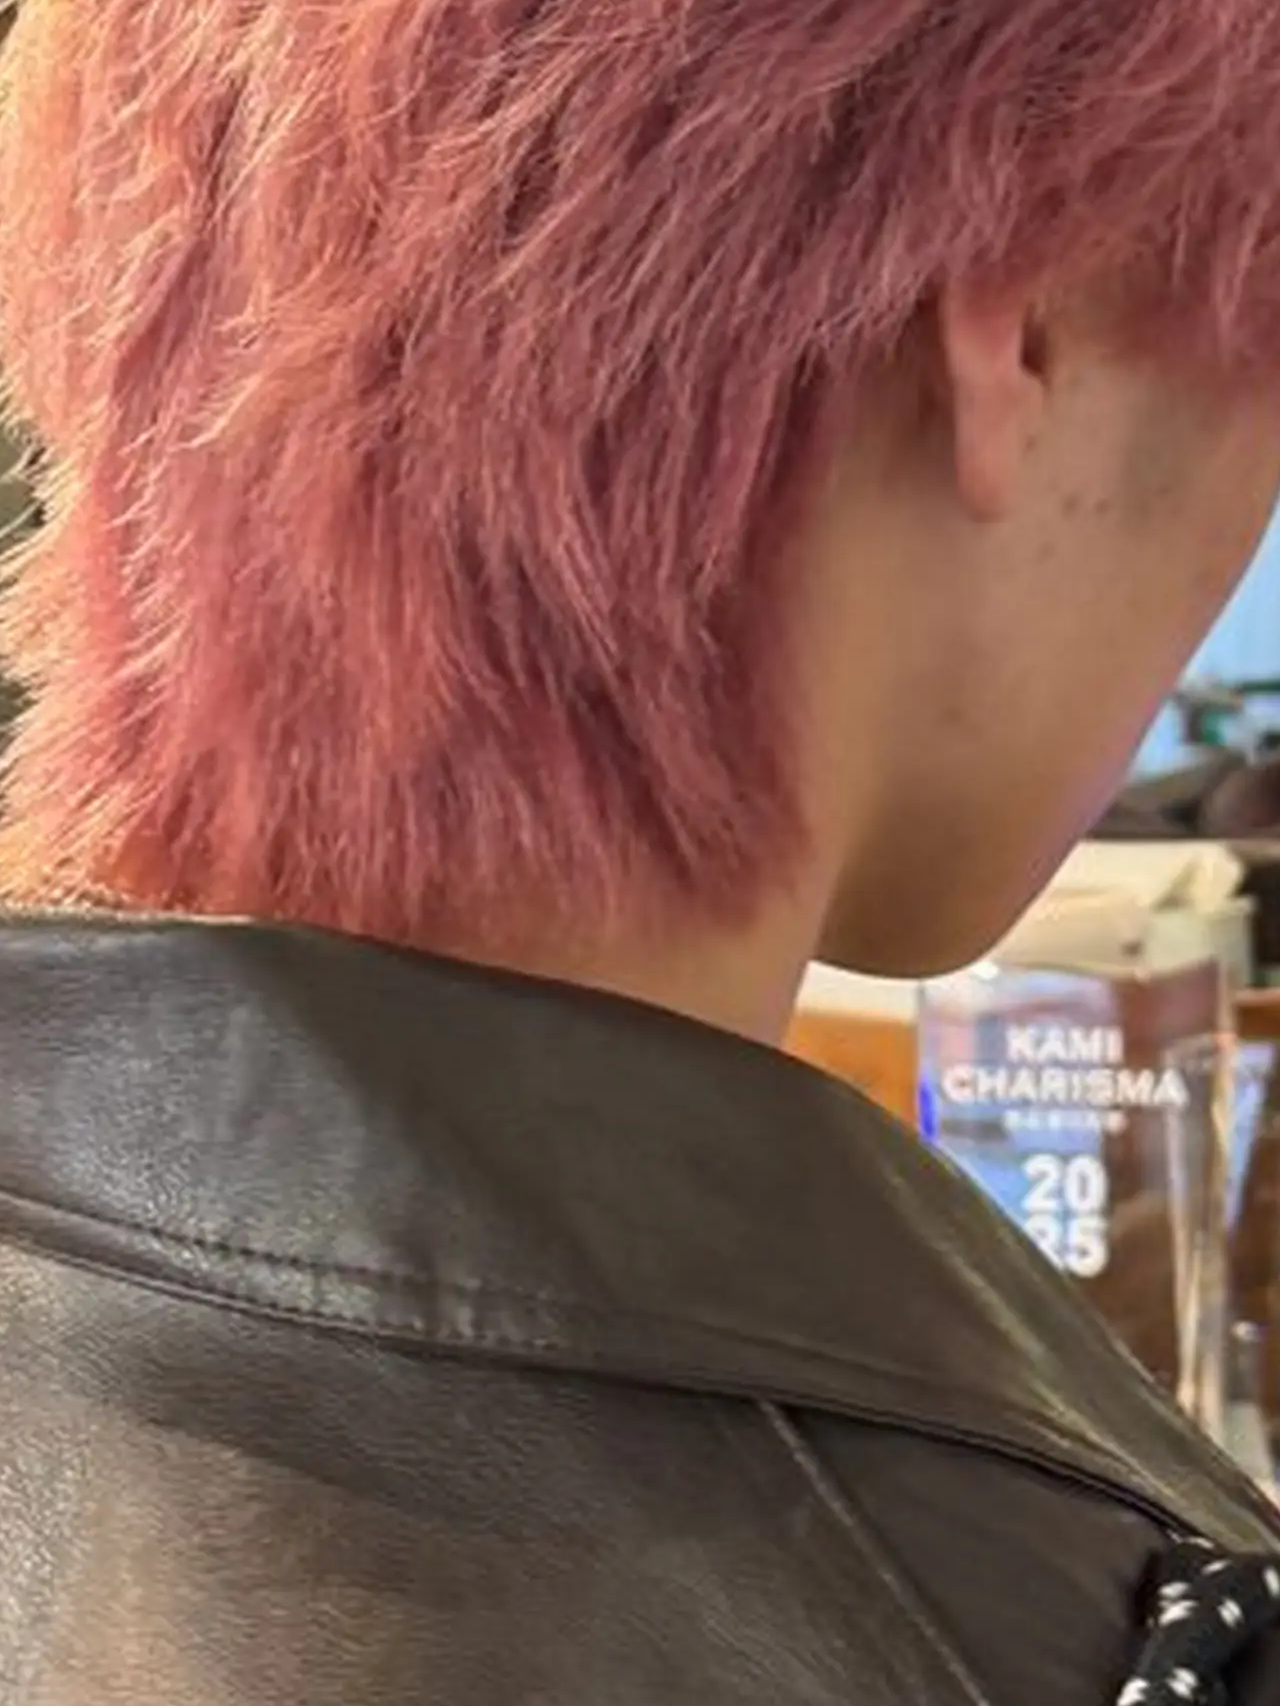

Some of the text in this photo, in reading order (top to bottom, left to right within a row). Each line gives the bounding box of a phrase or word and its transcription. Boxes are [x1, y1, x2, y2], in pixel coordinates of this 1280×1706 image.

[1006, 1026, 1122, 1062] KAMI
[942, 1065, 1188, 1104] CHARISMA
[1023, 1153, 1108, 1213] 20
